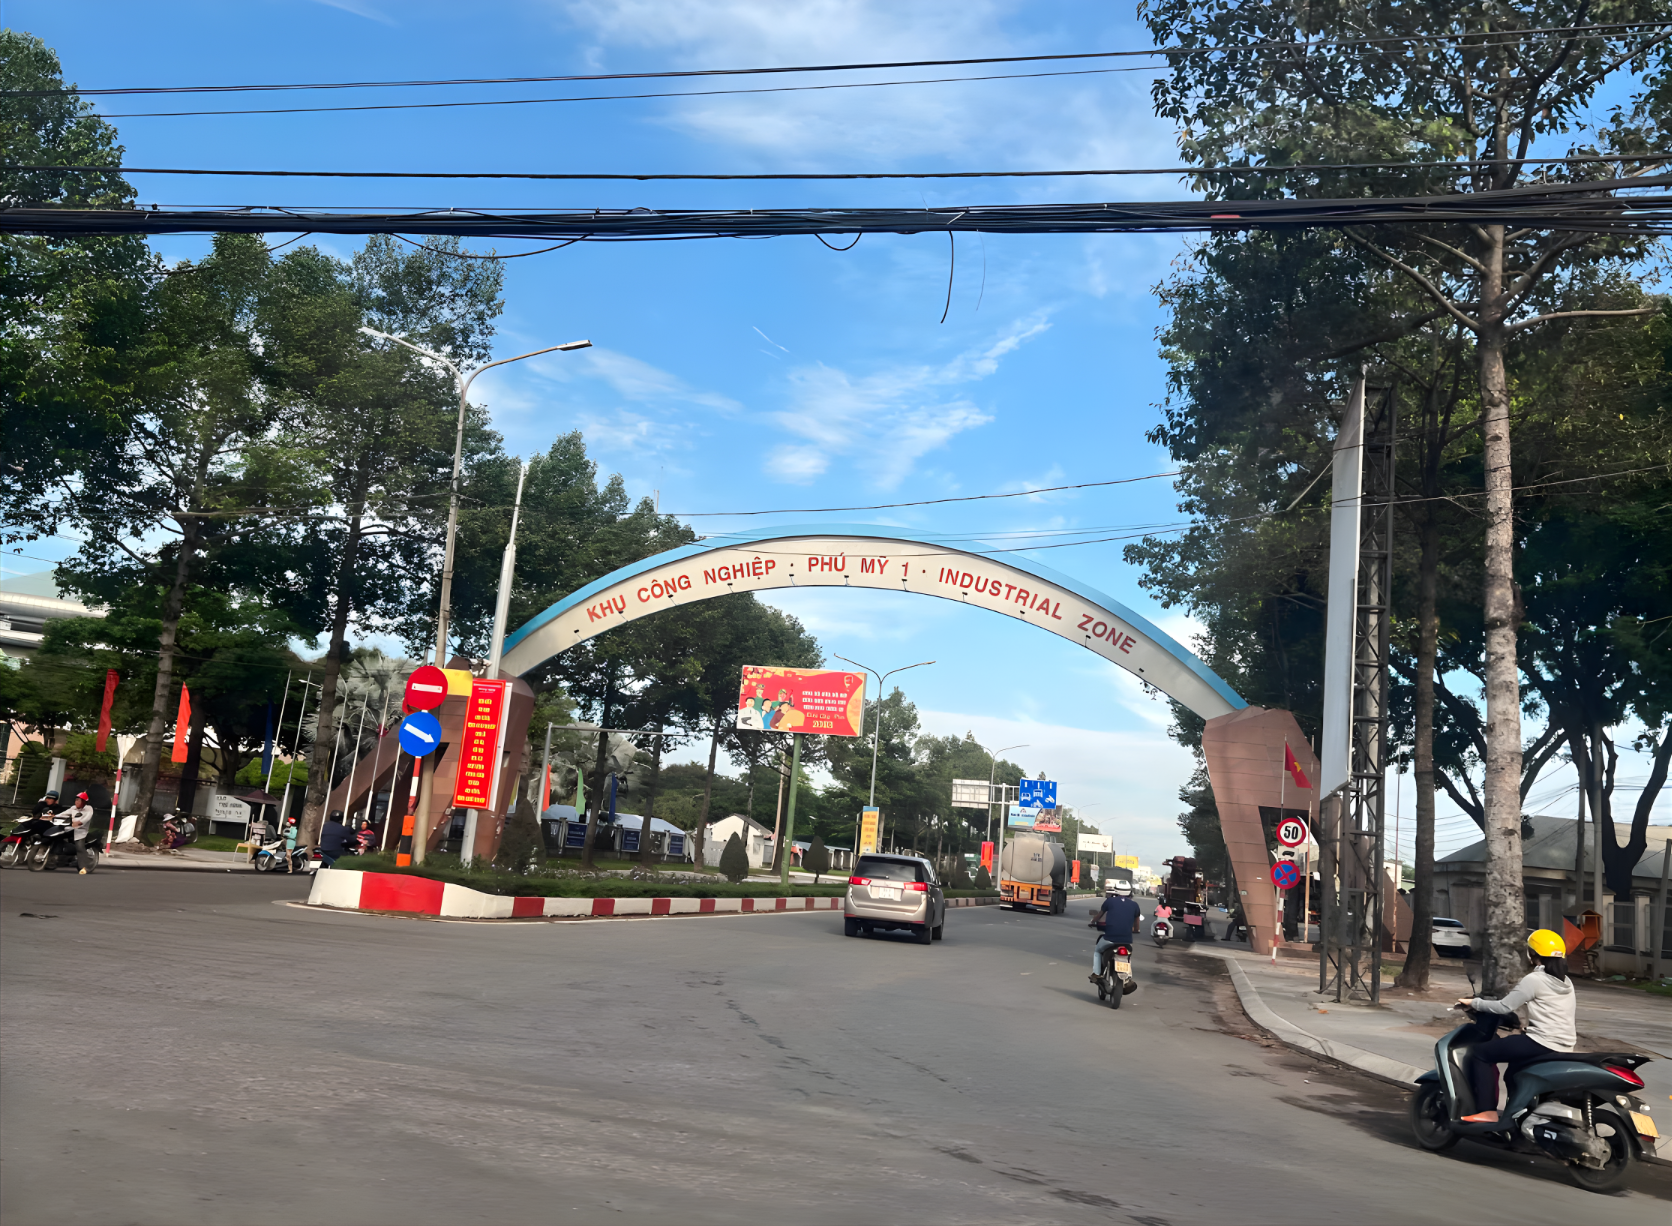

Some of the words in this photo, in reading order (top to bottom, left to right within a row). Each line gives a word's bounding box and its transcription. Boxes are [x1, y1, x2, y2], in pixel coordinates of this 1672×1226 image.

[586, 594, 627, 623] KHU
[636, 578, 692, 604] CÔNG
[703, 556, 777, 586] NGHIỆP
[807, 552, 846, 573] PHÚ
[860, 556, 890, 575] MỸ
[901, 561, 910, 577] 1
[938, 567, 1063, 621] INDUSTRIAL
[1077, 613, 1137, 655] ZONE
[1283, 825, 1299, 840] 50
